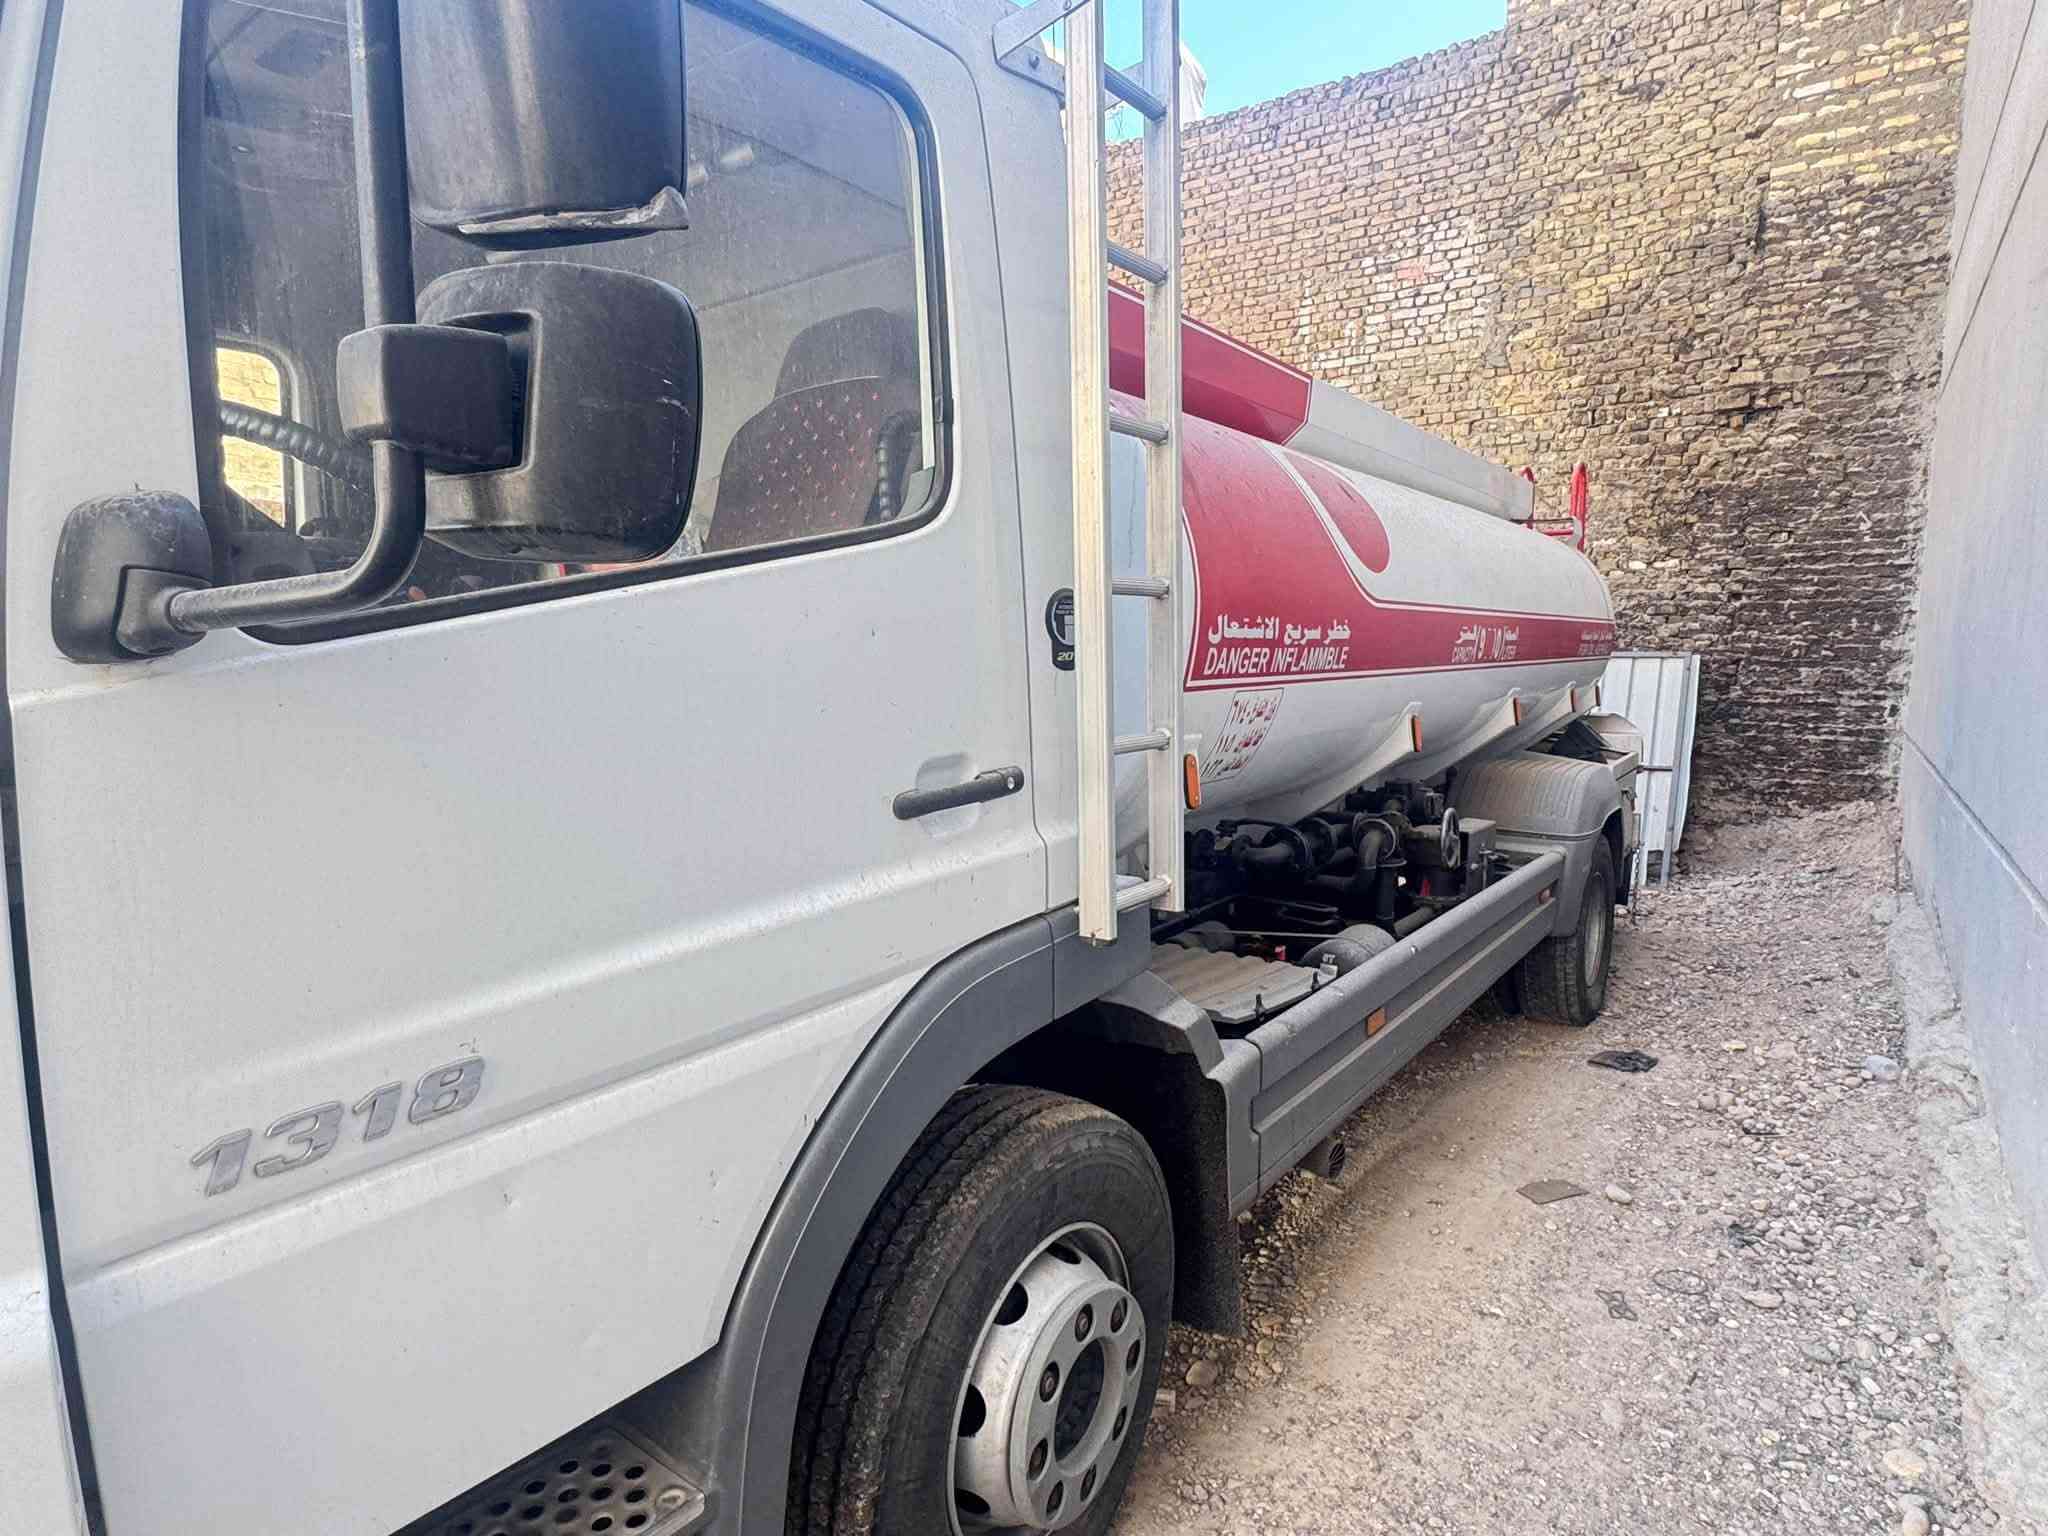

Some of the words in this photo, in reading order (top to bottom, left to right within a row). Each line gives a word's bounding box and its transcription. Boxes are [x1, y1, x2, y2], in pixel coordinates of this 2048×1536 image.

[1208, 613, 1280, 644] الاشتعال
[1284, 622, 1321, 645] سريع
[1323, 618, 1351, 644] خطر
[1203, 647, 1270, 676] DANGER
[191, 1055, 486, 1197] 1318
